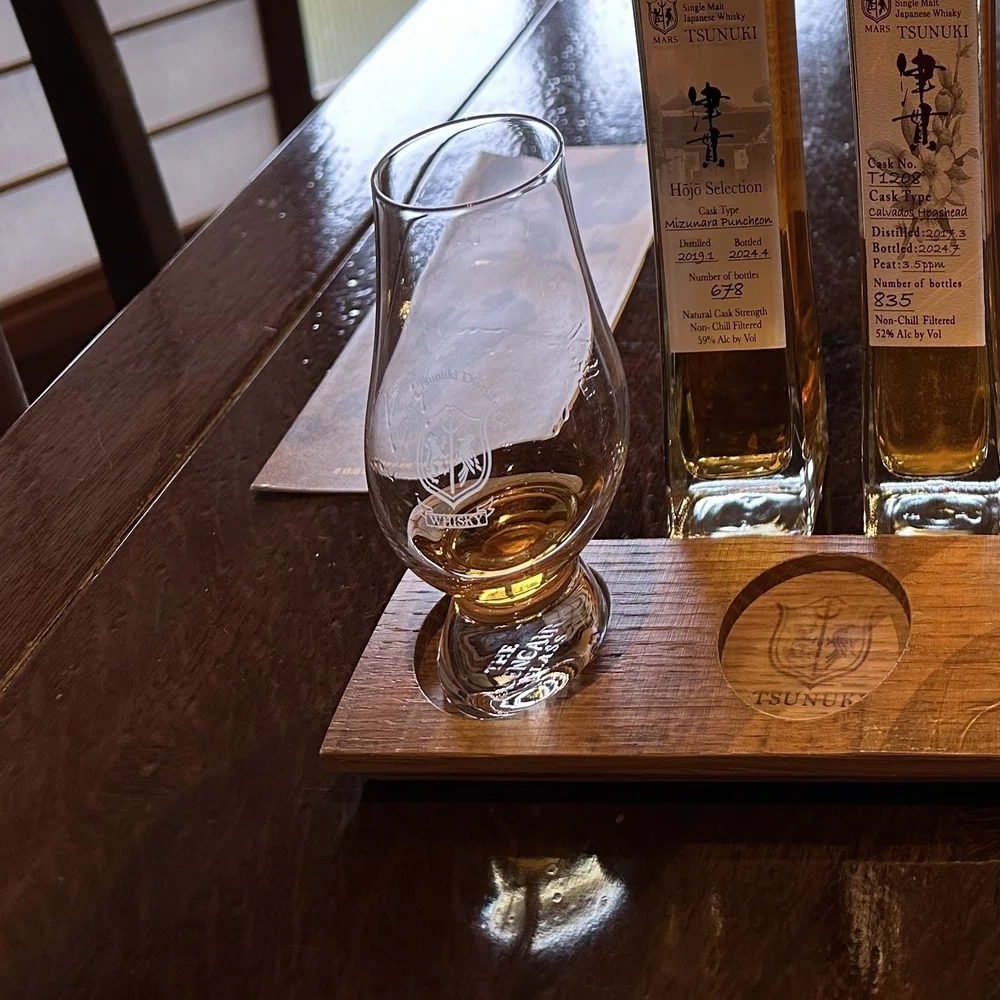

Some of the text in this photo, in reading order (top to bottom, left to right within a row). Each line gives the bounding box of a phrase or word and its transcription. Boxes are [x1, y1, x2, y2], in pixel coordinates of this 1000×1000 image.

[682, 2, 725, 14] Single Malt
[894, 0, 919, 9] Single
[683, 12, 745, 24] Japanese Whisky
[895, 8, 962, 19] Japanese Whisky
[684, 26, 757, 43] TSUNUKI
[864, 25, 891, 33] MARS
[897, 24, 969, 39] TSUNUKI
[653, 36, 678, 44] MARS
[867, 157, 917, 169] Cask No.
[867, 171, 921, 185] T1208
[670, 180, 763, 200] Hōjō Selection
[869, 189, 932, 206] Cask Type
[698, 205, 740, 216] Cask Type
[868, 206, 968, 220] Calvados Hogshead
[665, 215, 773, 229] Mizunara Puncheon
[679, 237, 762, 248] Distilled Bottled
[678, 248, 769, 264] 2019.1 2024.4
[688, 270, 759, 282] Number of bottles
[873, 278, 962, 288] Number of bottles
[711, 282, 744, 300] 678
[874, 292, 914, 307] 835
[682, 307, 768, 319] Natural Cask Strength
[733, 320, 762, 330] Filtered
[922, 315, 956, 325] Filtered
[698, 333, 757, 345] 59% Alc by Vol
[875, 329, 942, 341] 52% Alc by Vol
[429, 514, 483, 527] WHISKY
